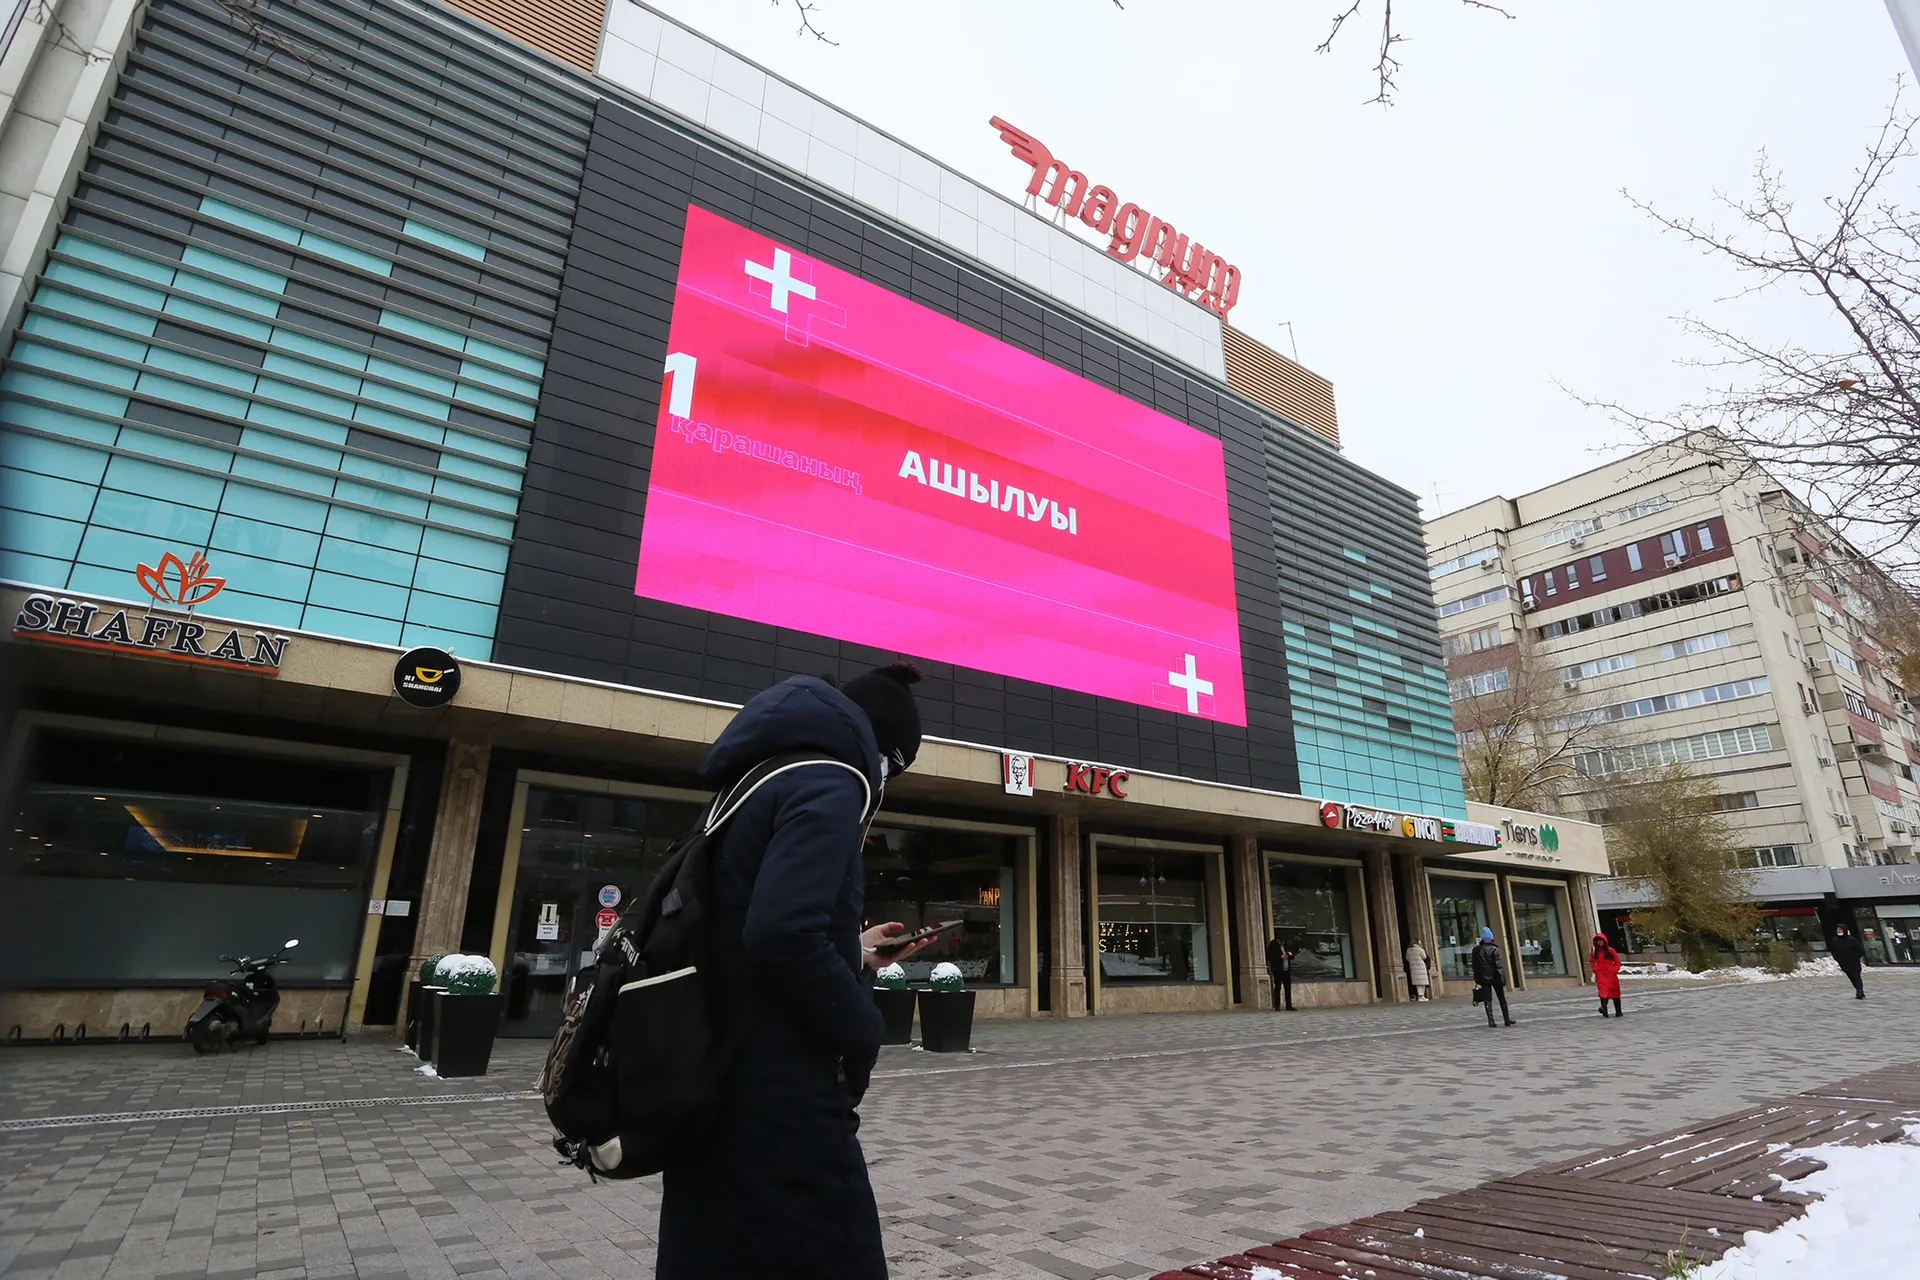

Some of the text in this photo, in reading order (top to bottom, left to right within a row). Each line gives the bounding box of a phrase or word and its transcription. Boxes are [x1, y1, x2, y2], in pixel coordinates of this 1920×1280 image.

[1020, 150, 1242, 312] magnum
[664, 352, 697, 419] 1
[898, 449, 1077, 535] АШЫЛУЫ
[14, 593, 291, 668] SHAFRAN
[1063, 761, 1130, 799] KFC
[1345, 806, 1377, 829] Pizza
[1501, 817, 1538, 846] Tiens
